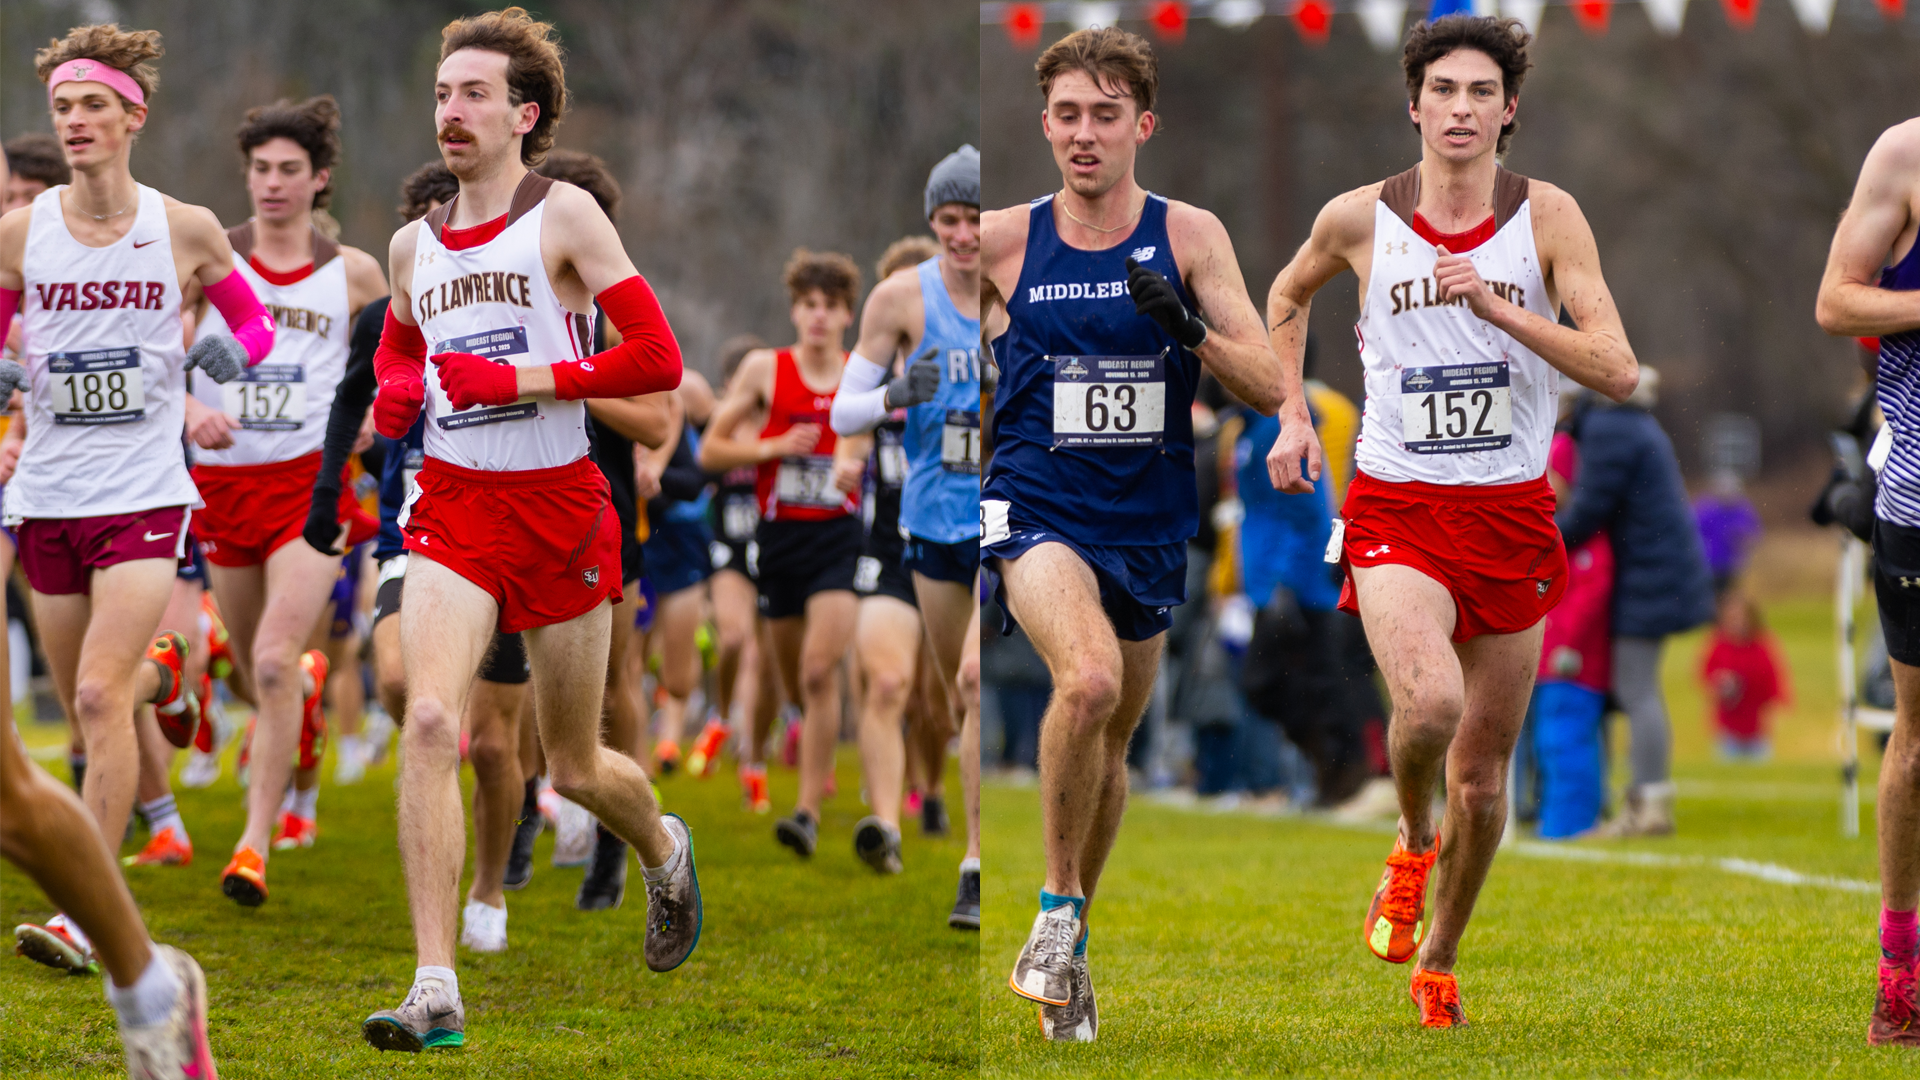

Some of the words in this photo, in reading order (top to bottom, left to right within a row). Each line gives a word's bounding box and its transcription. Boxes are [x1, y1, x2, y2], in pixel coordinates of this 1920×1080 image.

[36, 280, 166, 311] VASSAR
[419, 286, 439, 327] ST.
[440, 271, 534, 314] LAWRENCE
[1029, 277, 1167, 304] MIDDLEB
[1390, 278, 1420, 316] ST.
[1422, 277, 1525, 309] LNCE
[466, 335, 490, 347] MIDEAST
[491, 331, 514, 343] REGION
[81, 352, 108, 361] MIDEAST
[1098, 360, 1128, 369] MIDEAST
[1130, 360, 1155, 368] REGION
[1442, 368, 1472, 377] MIDEAST
[1474, 366, 1498, 375] REGION
[64, 371, 128, 412] 188
[238, 384, 290, 420] 152
[1086, 384, 1136, 432] 63
[1420, 390, 1494, 440] 152
